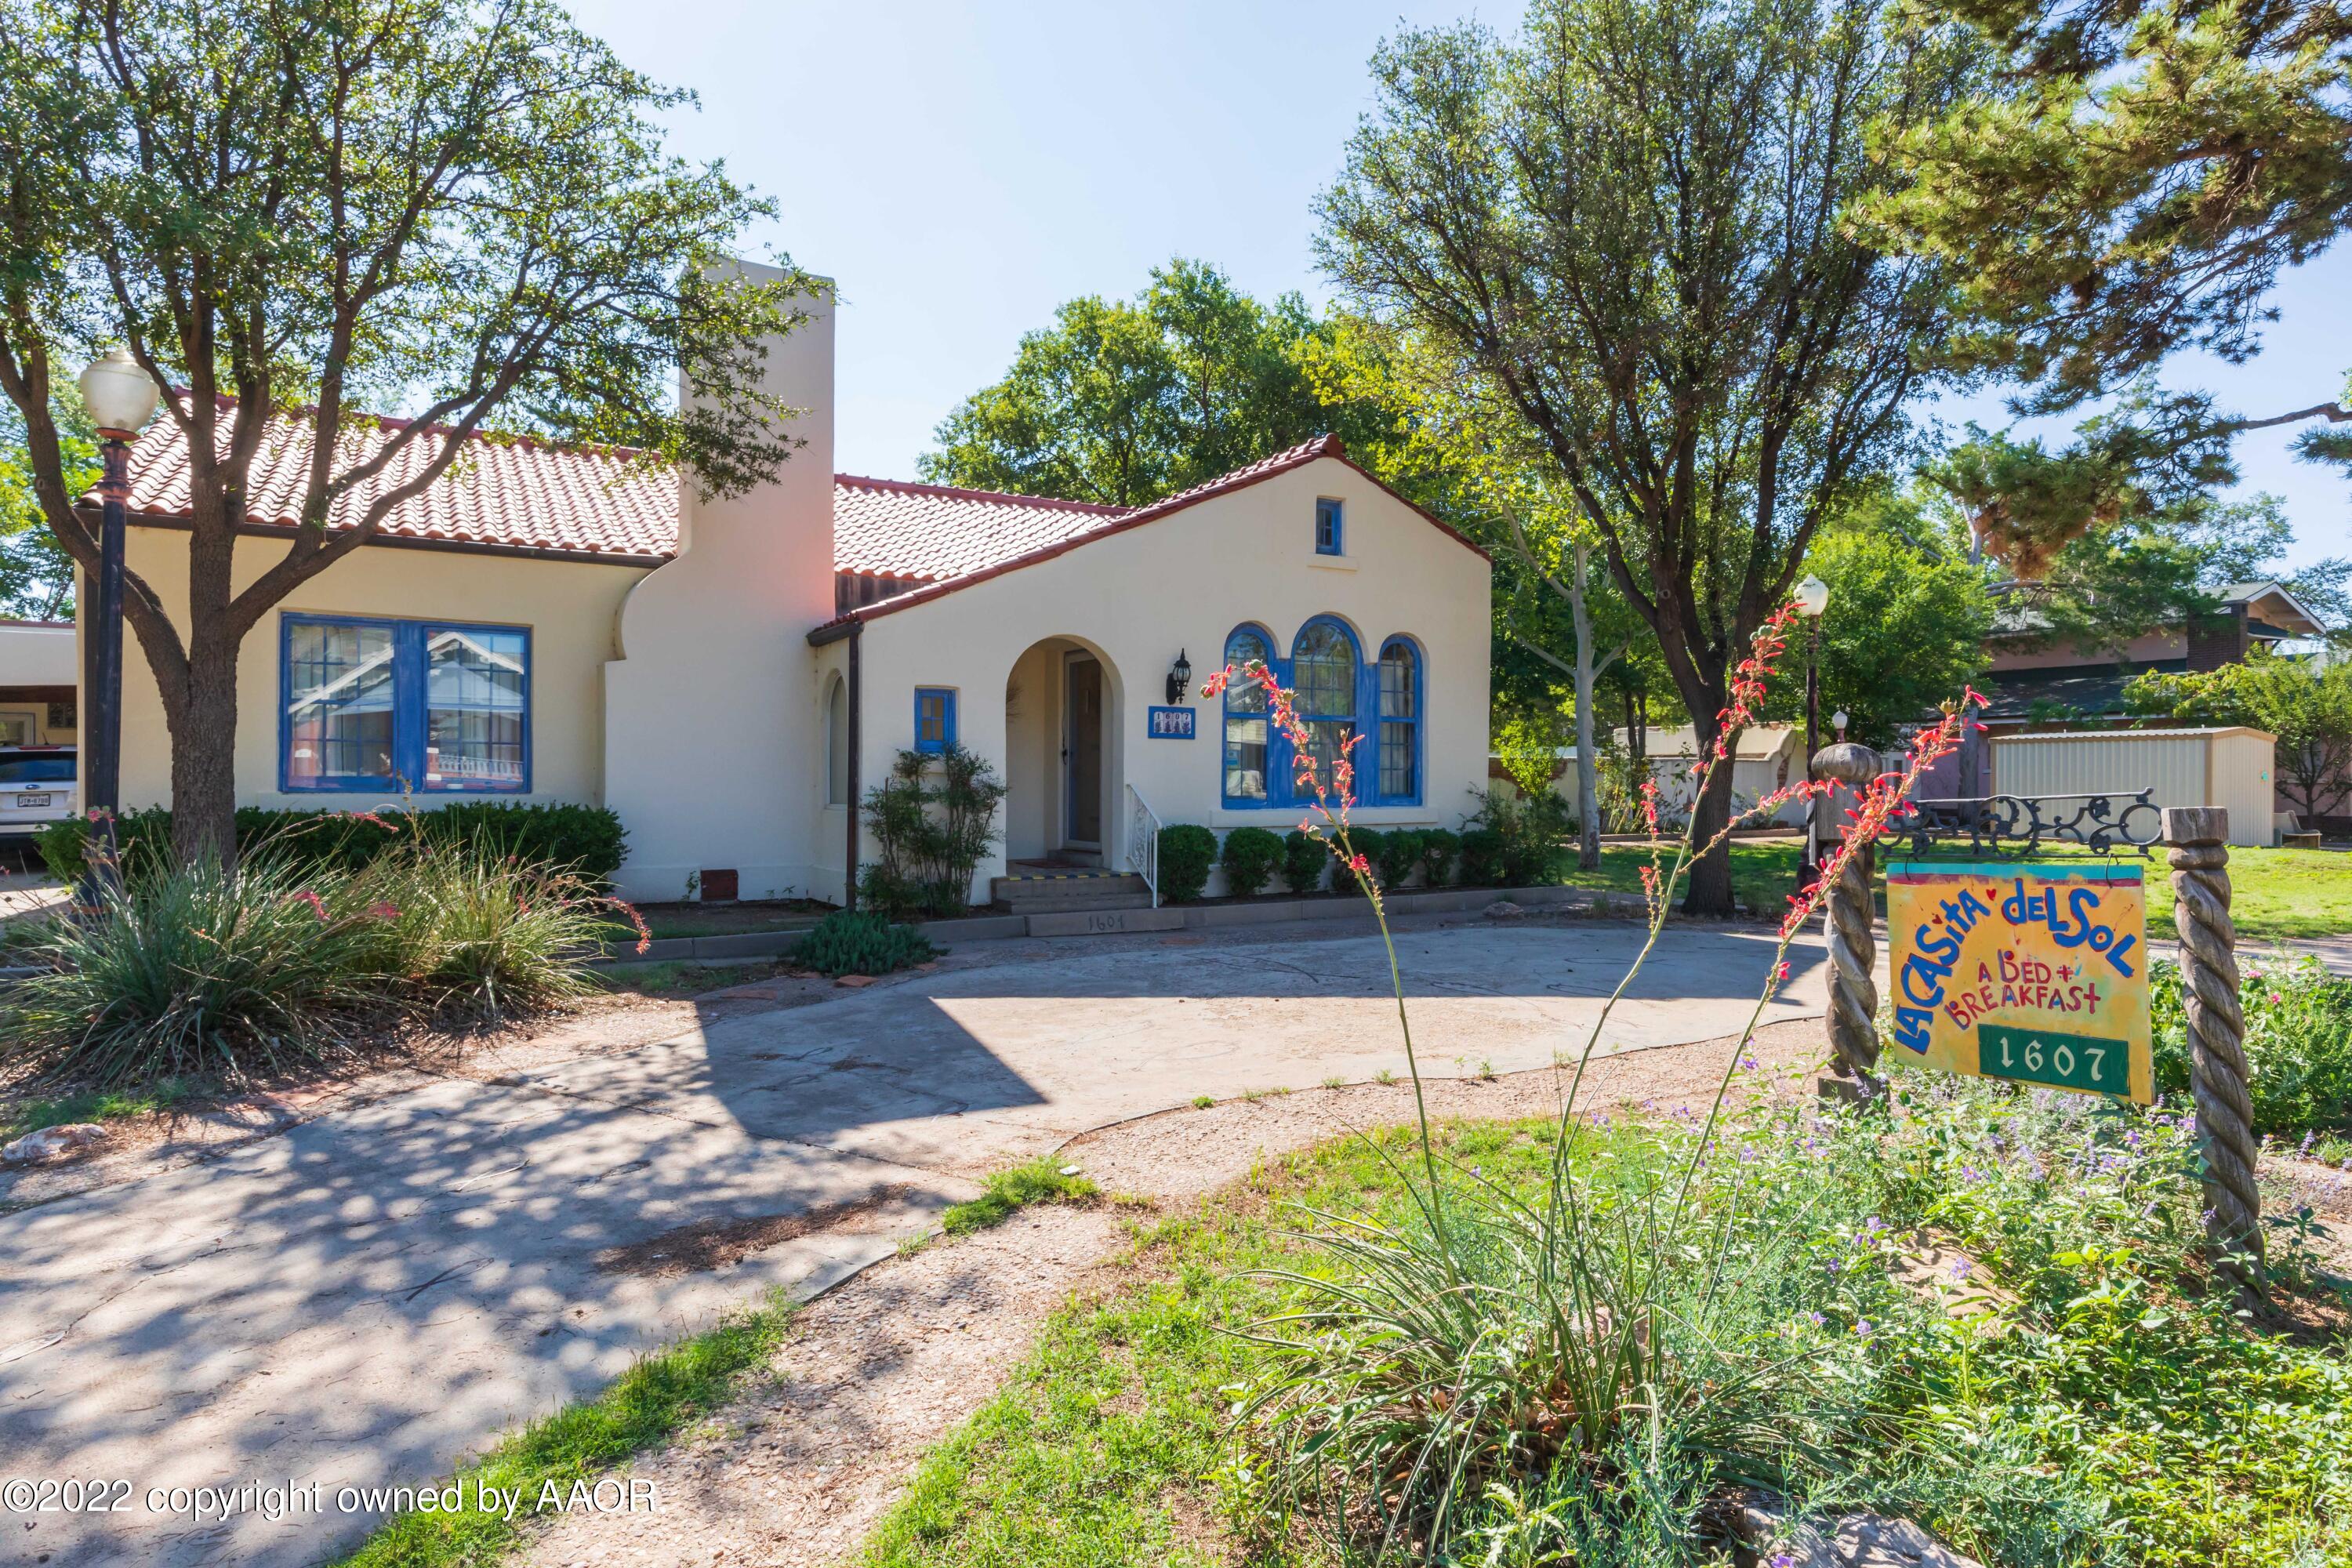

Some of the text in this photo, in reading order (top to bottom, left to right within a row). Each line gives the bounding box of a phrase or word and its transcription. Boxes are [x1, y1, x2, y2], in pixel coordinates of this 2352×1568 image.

[1977, 961, 1992, 983] A
[1997, 949, 2052, 984] BED
[1894, 1003, 1933, 1055] LA
[1999, 1036, 2107, 1081] 1607
